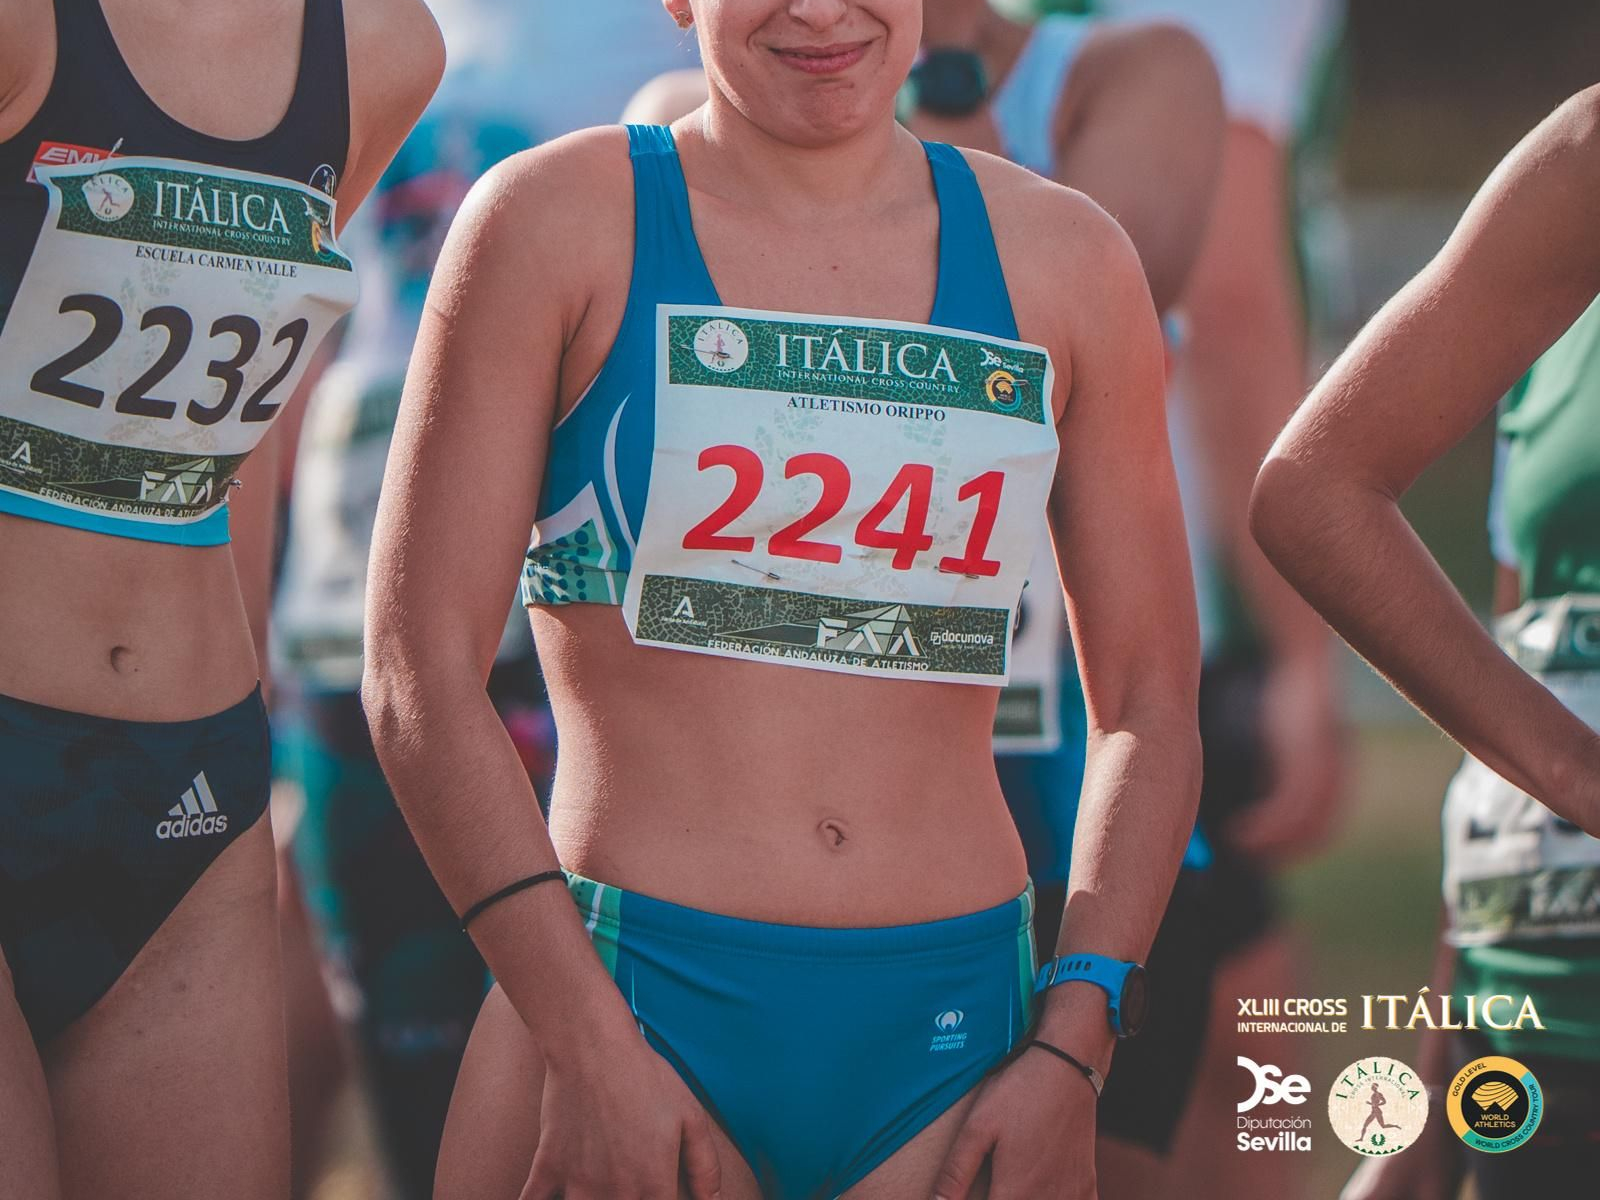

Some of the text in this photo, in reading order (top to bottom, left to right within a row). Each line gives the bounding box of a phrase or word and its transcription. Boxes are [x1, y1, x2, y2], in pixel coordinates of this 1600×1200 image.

[153, 177, 292, 235] ITÁLICA
[152, 219, 292, 247] INTERNATIONAL CROSS COUNTRY
[135, 245, 298, 279] ESCUELA CARMEN VALLE
[29, 293, 309, 426] 2232
[776, 328, 960, 383] ITÁLICA
[778, 369, 961, 394] INTERNATIONAL CROSS COUNTRY
[786, 396, 946, 422] ATLETISMO ORIPPO
[39, 487, 108, 511] FEDERACIÓN
[111, 502, 162, 517] ANDALUZA
[164, 508, 175, 518] DE
[682, 444, 1005, 576] 2241
[941, 629, 994, 645] docunova
[707, 639, 929, 672] FEDERACIÓN ANDALUZA DE ATLETISMO
[156, 812, 228, 839] adidas
